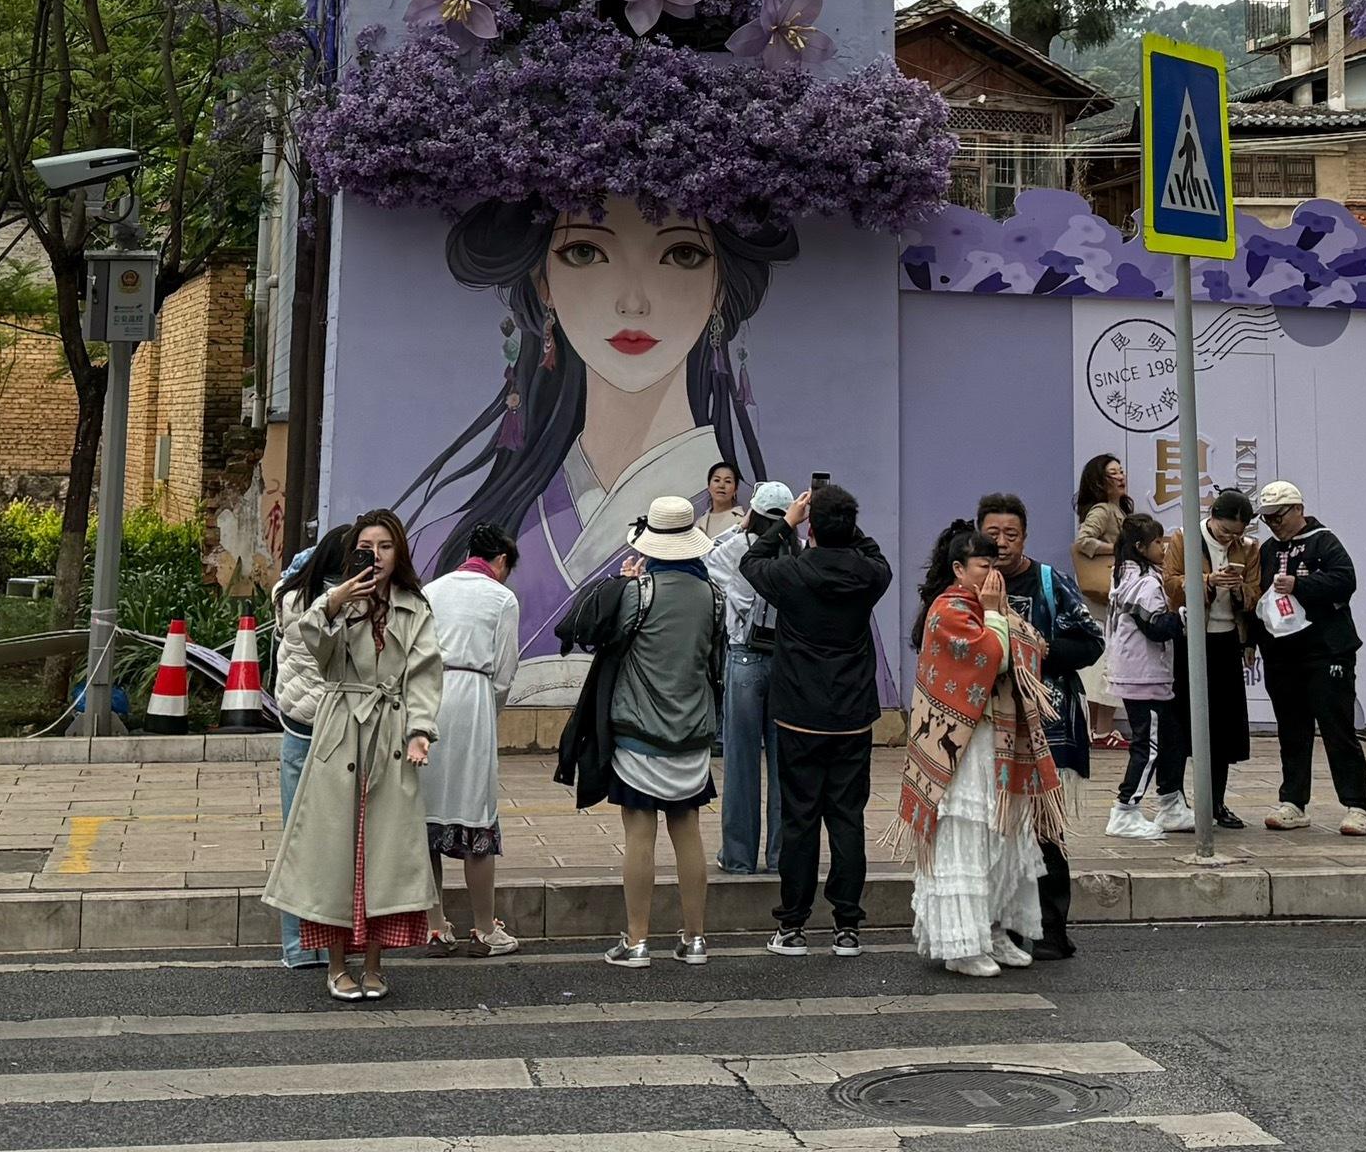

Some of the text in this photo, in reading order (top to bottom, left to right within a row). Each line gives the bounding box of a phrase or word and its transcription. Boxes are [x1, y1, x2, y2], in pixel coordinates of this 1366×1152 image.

[1110, 331, 1167, 352] 昆明
[1094, 357, 1179, 388] SINCE 198
[1107, 386, 1179, 423] 教场中路
